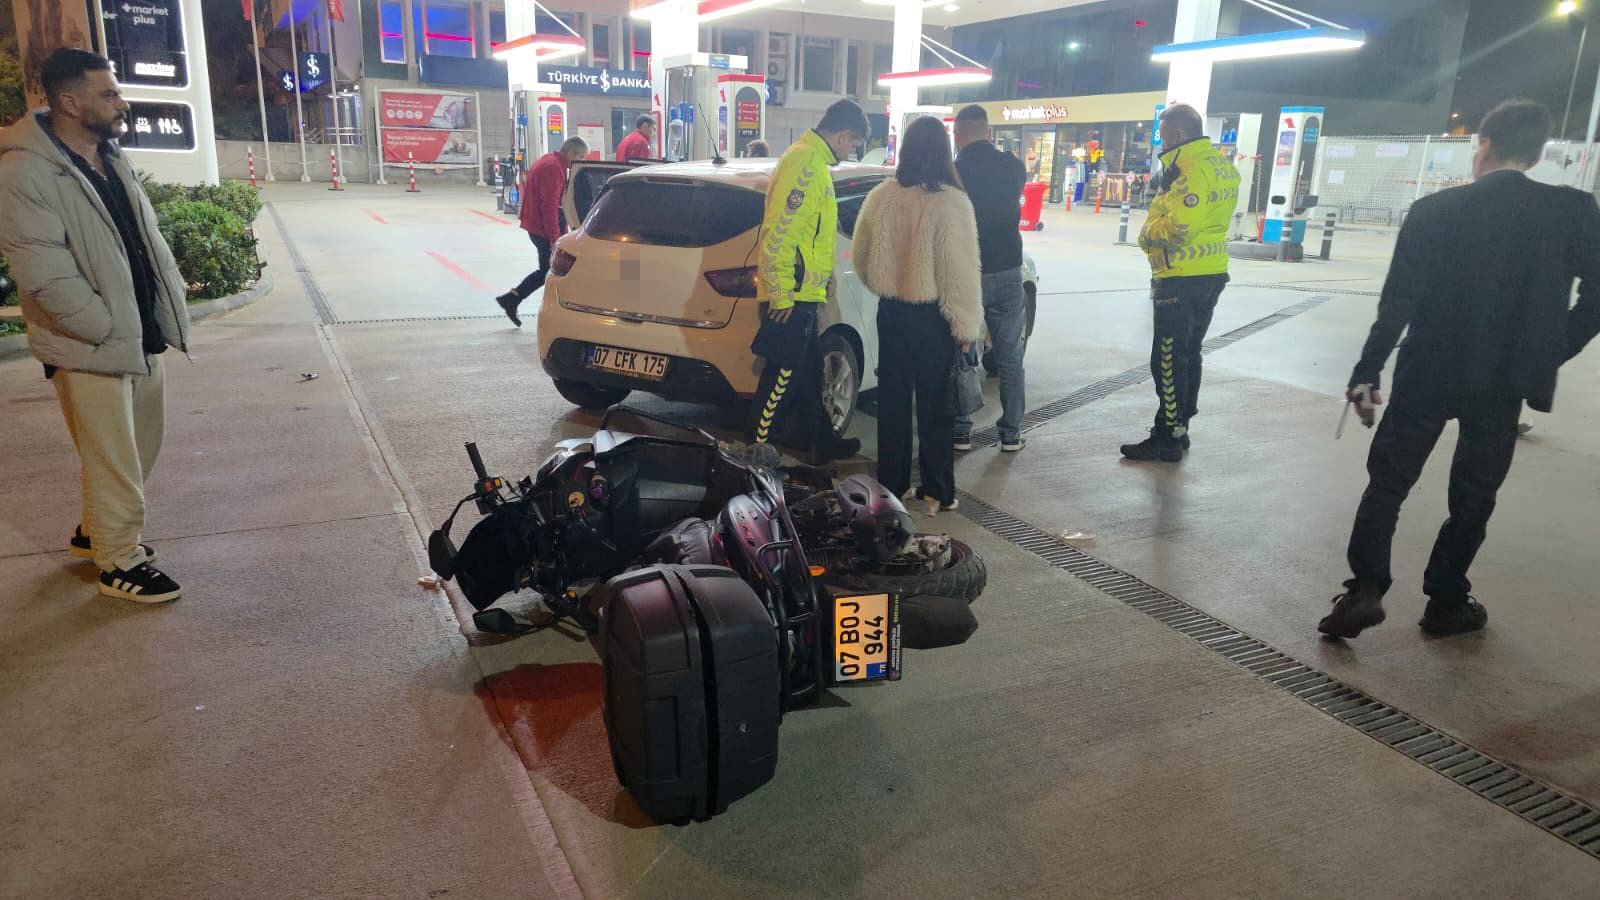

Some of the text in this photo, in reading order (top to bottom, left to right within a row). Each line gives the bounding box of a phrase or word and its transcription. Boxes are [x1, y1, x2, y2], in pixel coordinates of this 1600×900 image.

[132, 5, 169, 16] market
[133, 14, 156, 26] plus
[547, 70, 599, 85] TÜRKİYE
[611, 77, 653, 89] BANKA
[594, 348, 665, 374] 07 CFK 175
[840, 602, 860, 676] 07 BOJ
[864, 615, 884, 655] 944
[879, 663, 887, 673] TR
